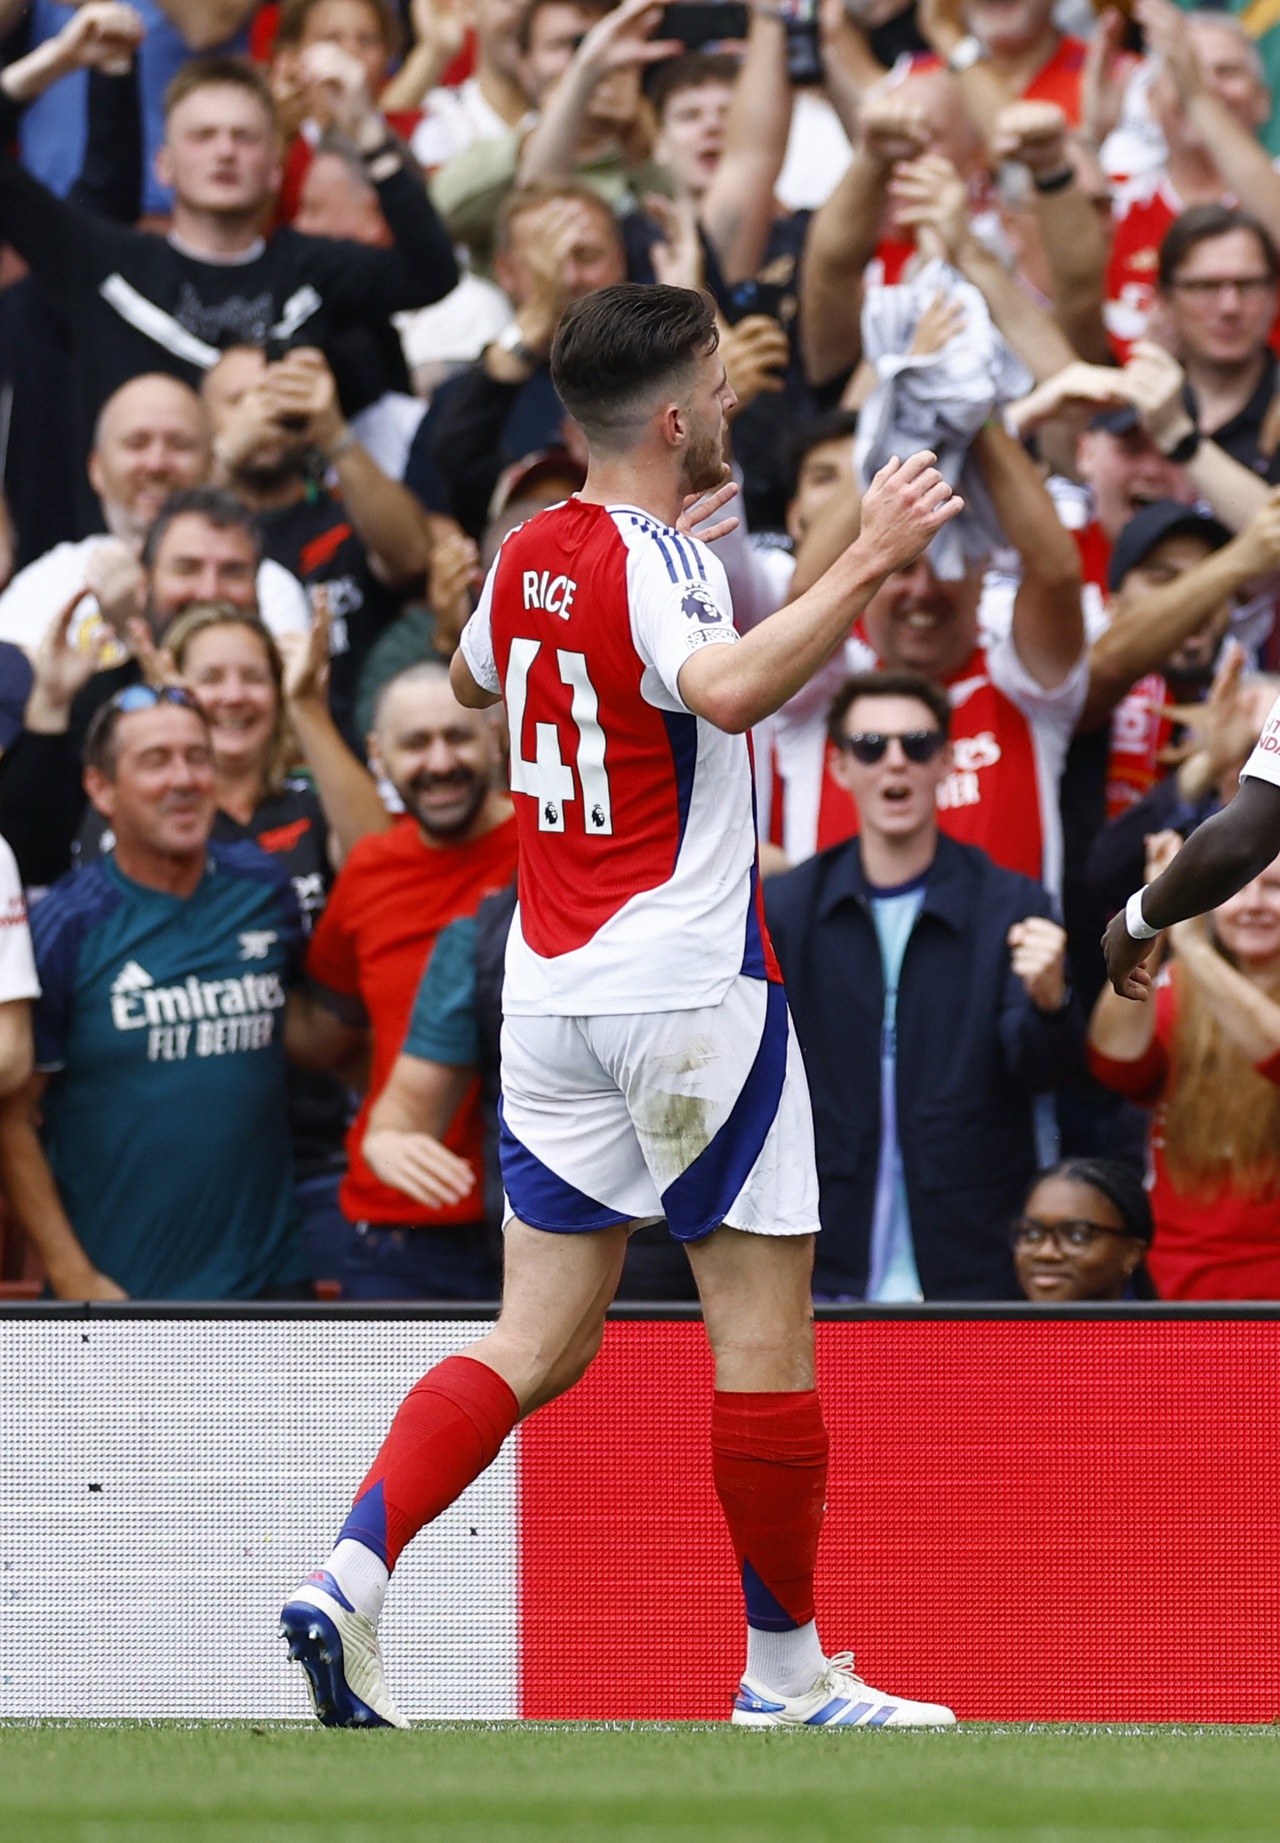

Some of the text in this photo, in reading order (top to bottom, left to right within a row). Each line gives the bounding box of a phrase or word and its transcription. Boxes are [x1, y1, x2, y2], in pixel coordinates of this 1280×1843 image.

[522, 570, 577, 621] RICE
[504, 637, 614, 836] 41
[110, 971, 287, 1031] Emirates
[147, 1011, 275, 1063] FLY BETTER
